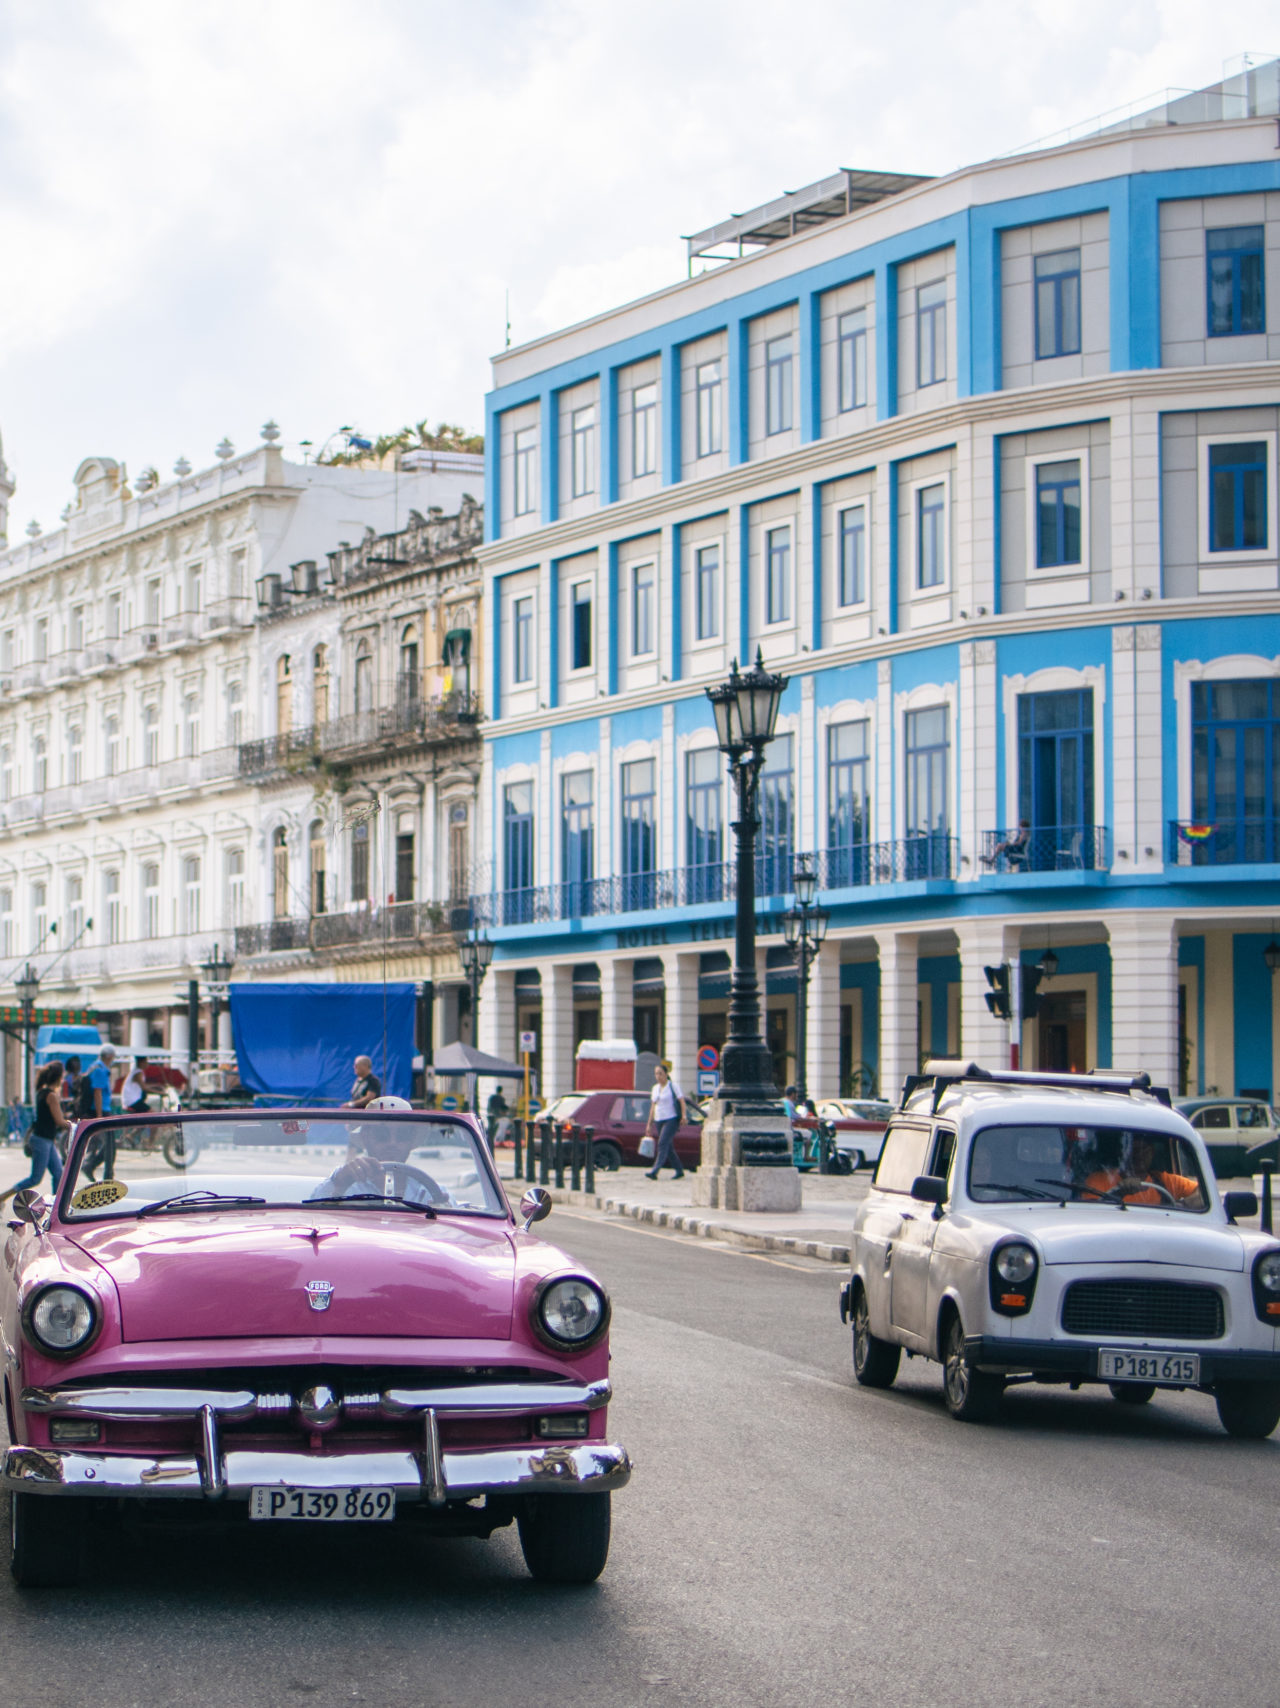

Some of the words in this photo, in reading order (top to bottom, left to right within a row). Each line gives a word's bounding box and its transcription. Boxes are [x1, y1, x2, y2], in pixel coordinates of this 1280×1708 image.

[310, 1282, 329, 1290] FORD
[1162, 1357, 1193, 1379] 615
[344, 1491, 391, 1518] 869
